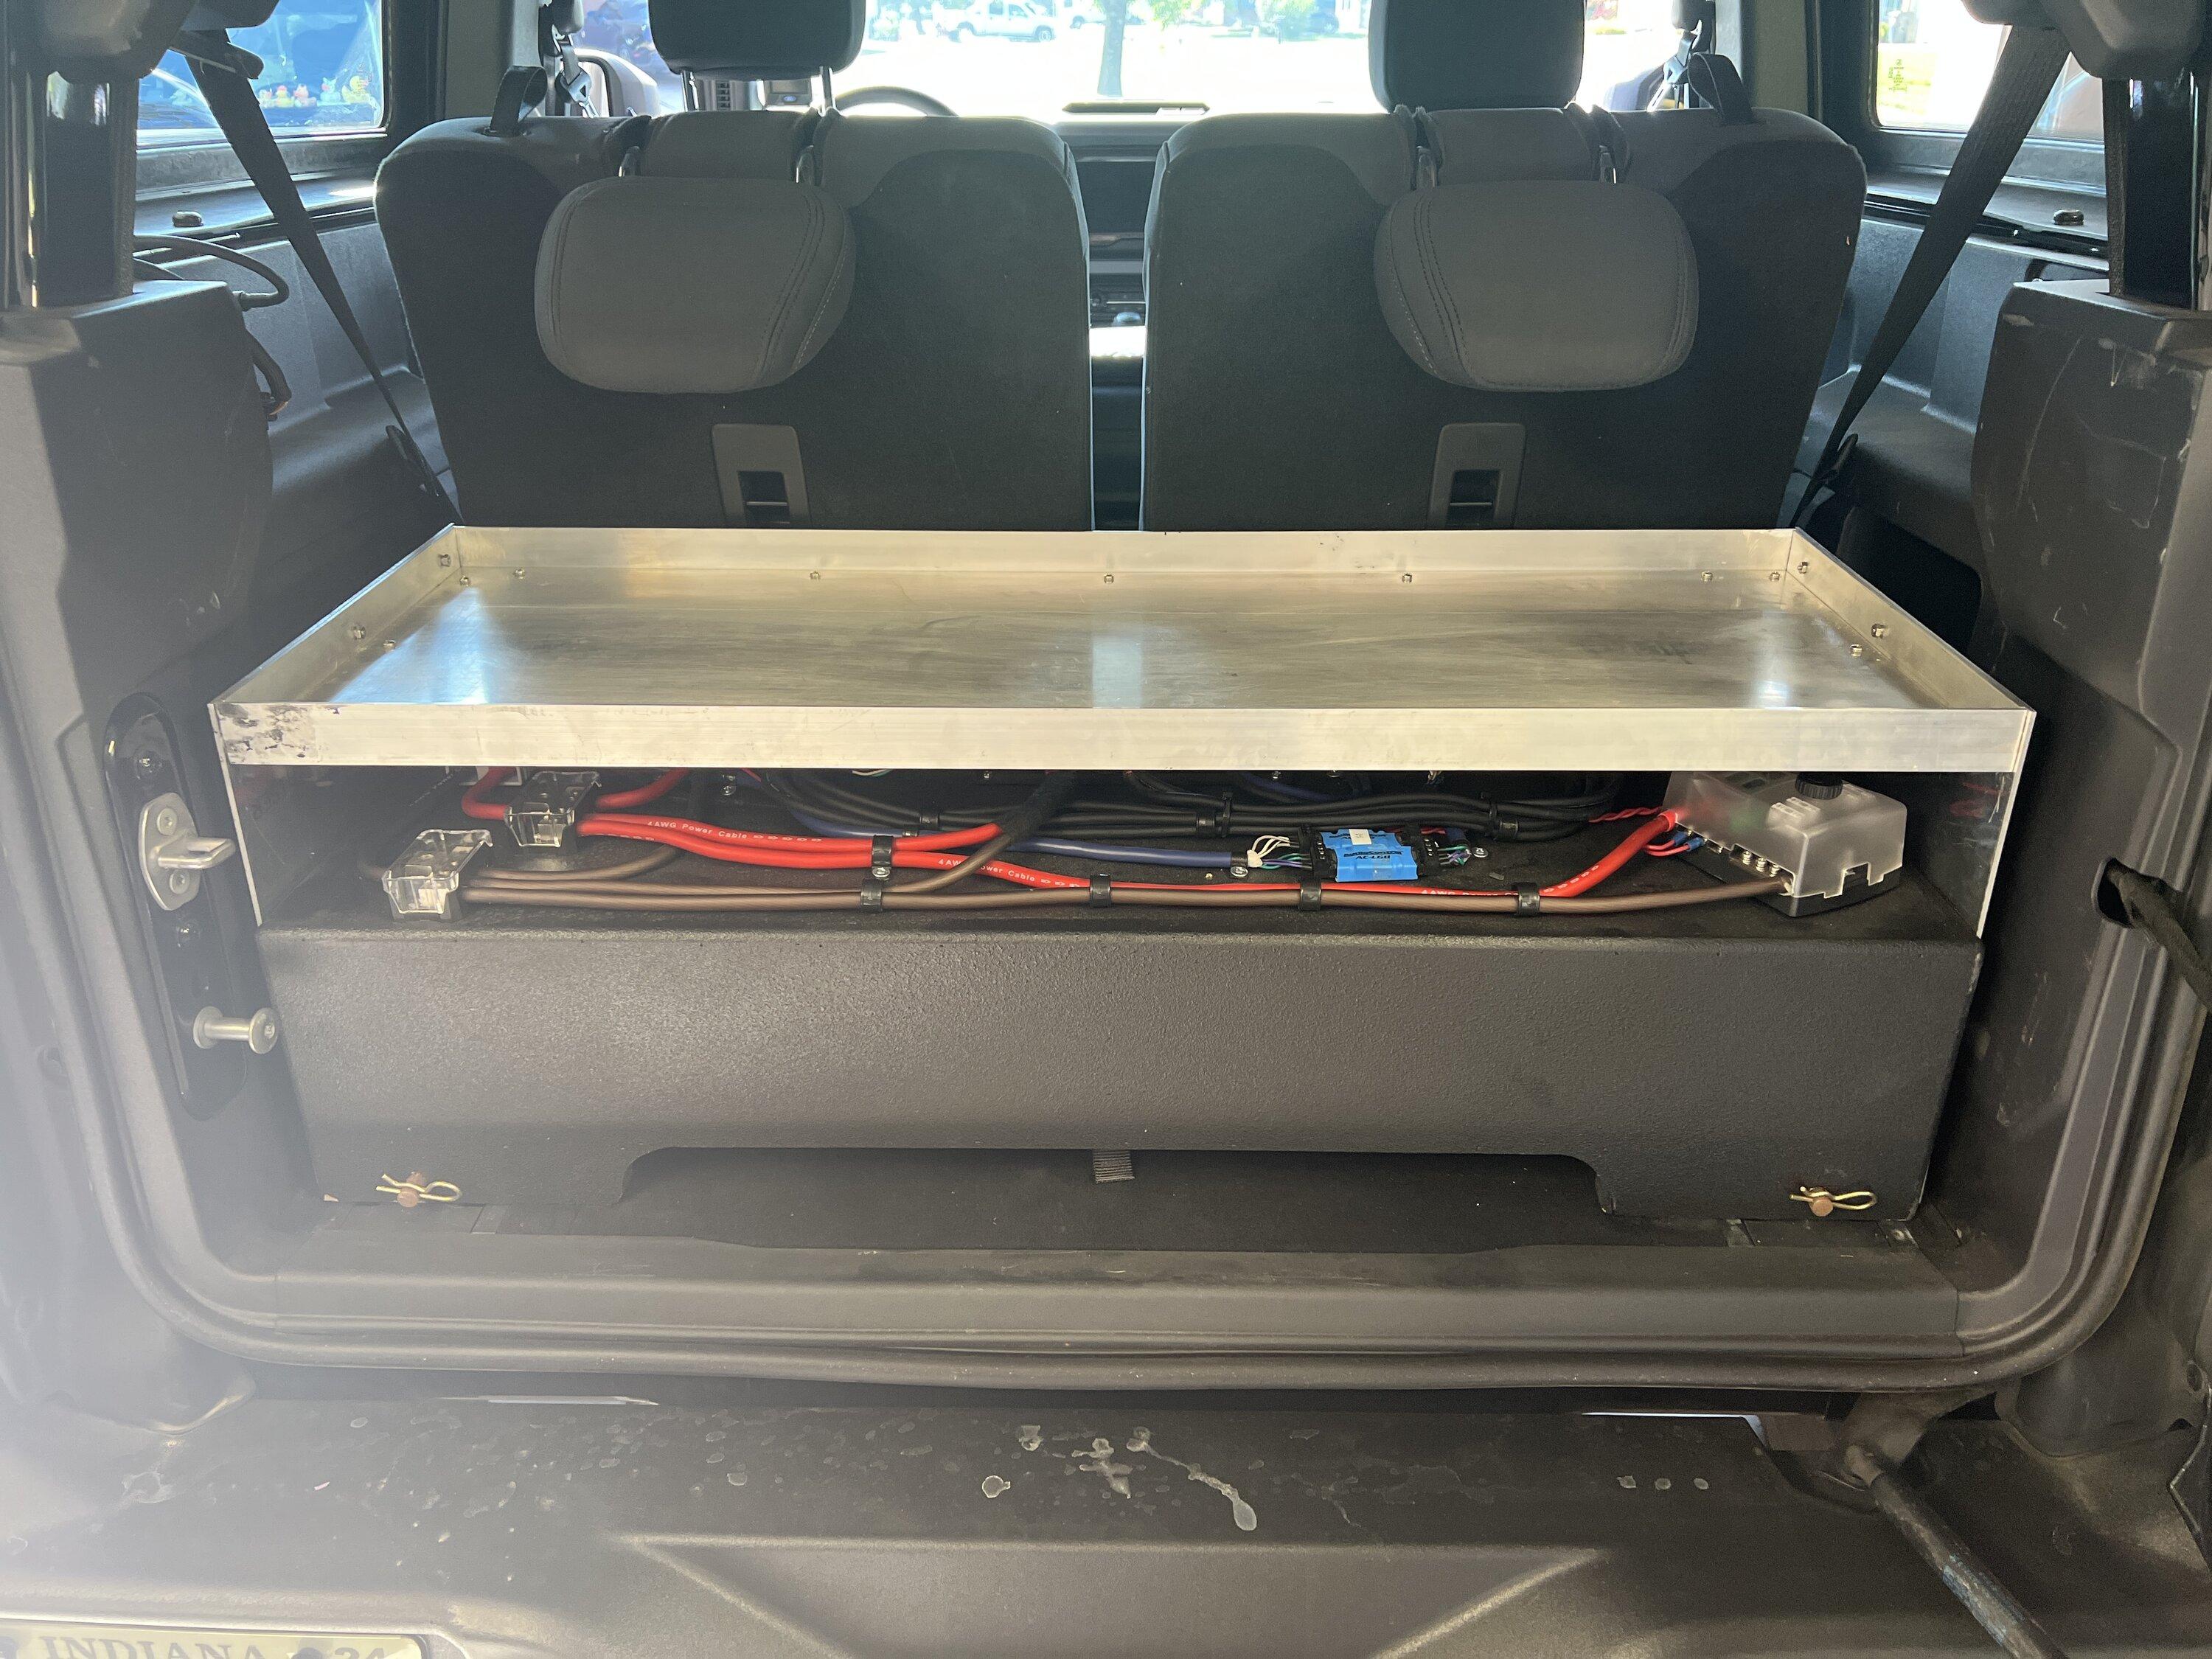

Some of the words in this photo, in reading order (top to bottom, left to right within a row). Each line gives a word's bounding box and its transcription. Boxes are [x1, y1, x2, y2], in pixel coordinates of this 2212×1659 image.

[682, 824, 713, 835] Power
[718, 829, 748, 840] Cable
[938, 858, 961, 866] 4AW
[980, 866, 1004, 874] ower
[1008, 870, 1036, 882] Cable
[39, 1636, 266, 1659] INDIANA
